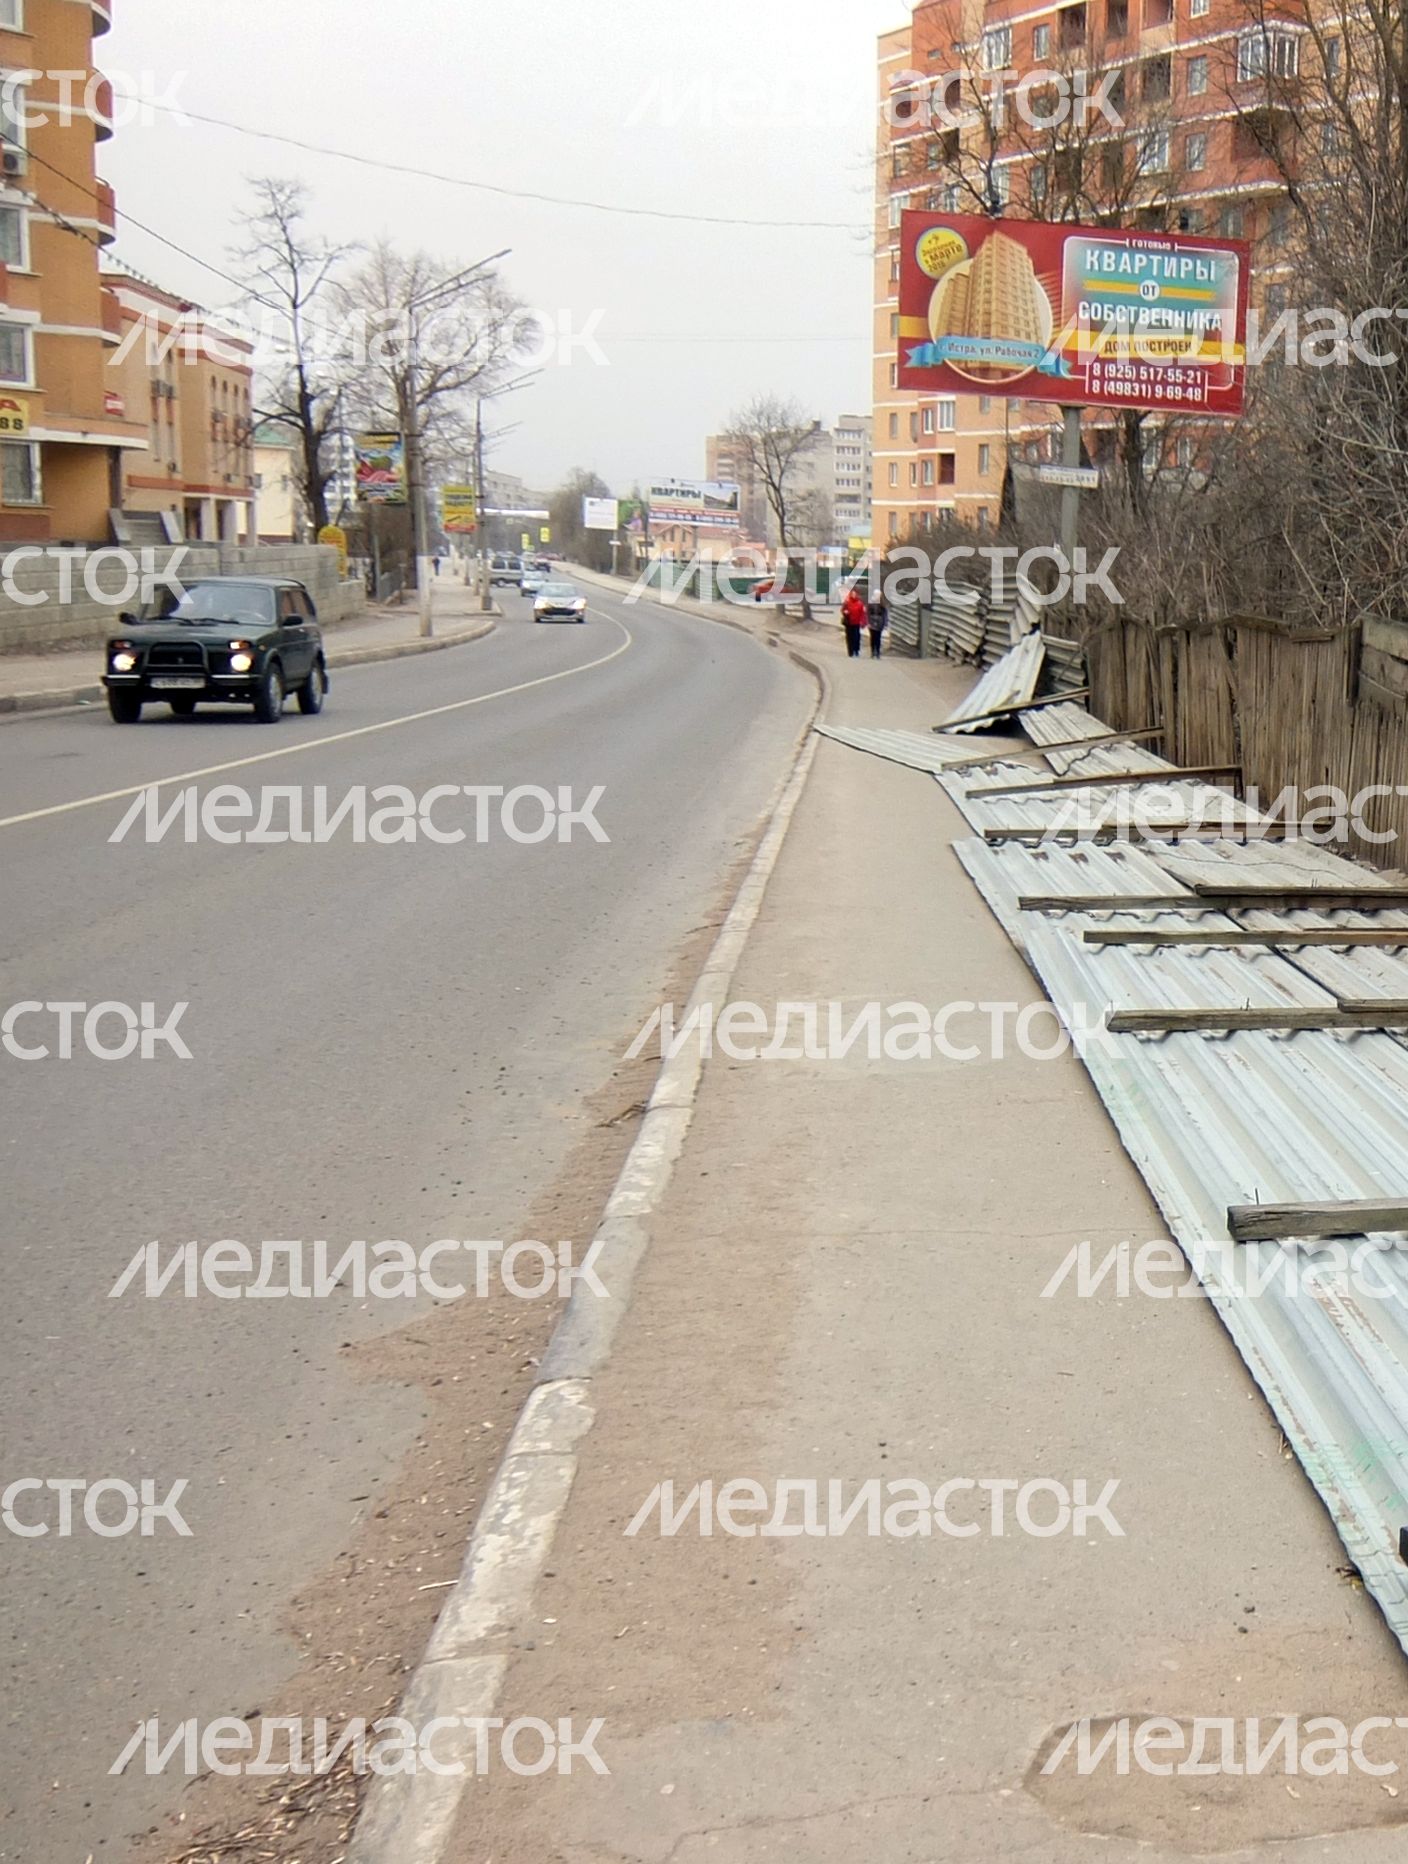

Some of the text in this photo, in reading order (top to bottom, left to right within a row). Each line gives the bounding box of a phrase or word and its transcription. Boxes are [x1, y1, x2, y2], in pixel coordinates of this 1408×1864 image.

[1085, 250, 1216, 282] КВАРТИРЫ
[1078, 301, 1222, 331] СОБСТВЕННИКА
[1104, 340, 1130, 354] ДОМ
[1092, 363, 1202, 384] 8 (925) 517-55-21
[1092, 380, 1202, 401] 8 (49831) 9-69-48
